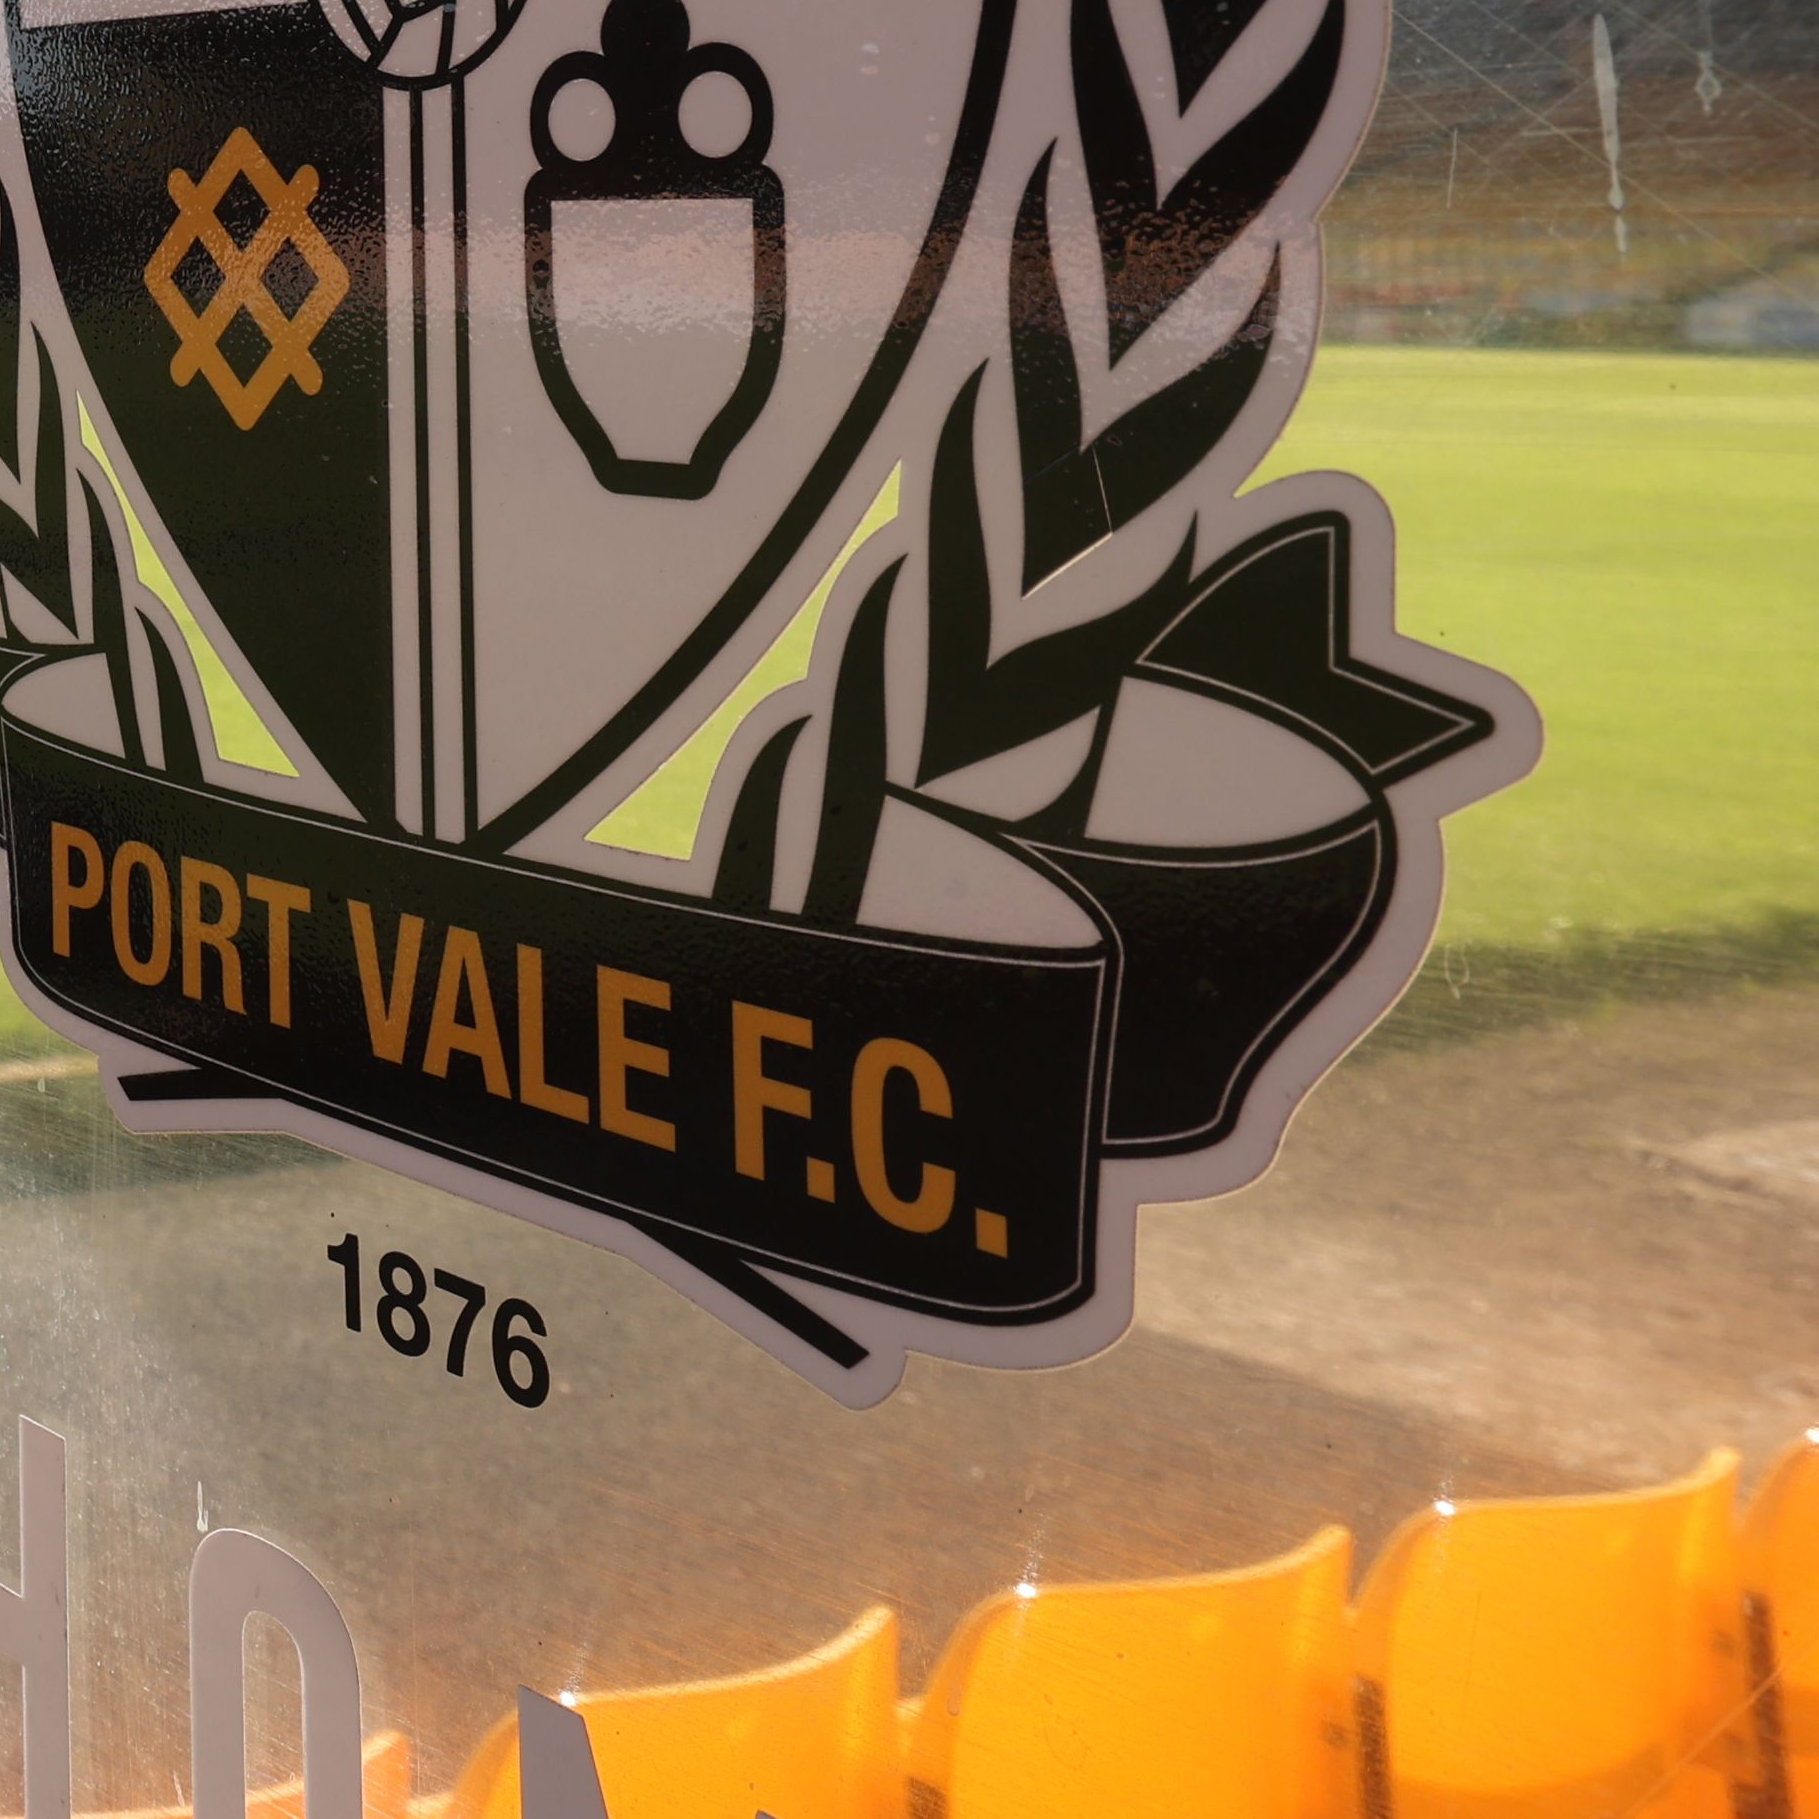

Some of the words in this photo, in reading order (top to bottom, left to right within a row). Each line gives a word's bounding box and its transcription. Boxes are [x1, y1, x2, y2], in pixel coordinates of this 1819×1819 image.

[49, 821, 313, 1029] PORT
[348, 896, 677, 1153] VALE
[730, 999, 1011, 1261] F.C.
[327, 1233, 551, 1409] 1876
